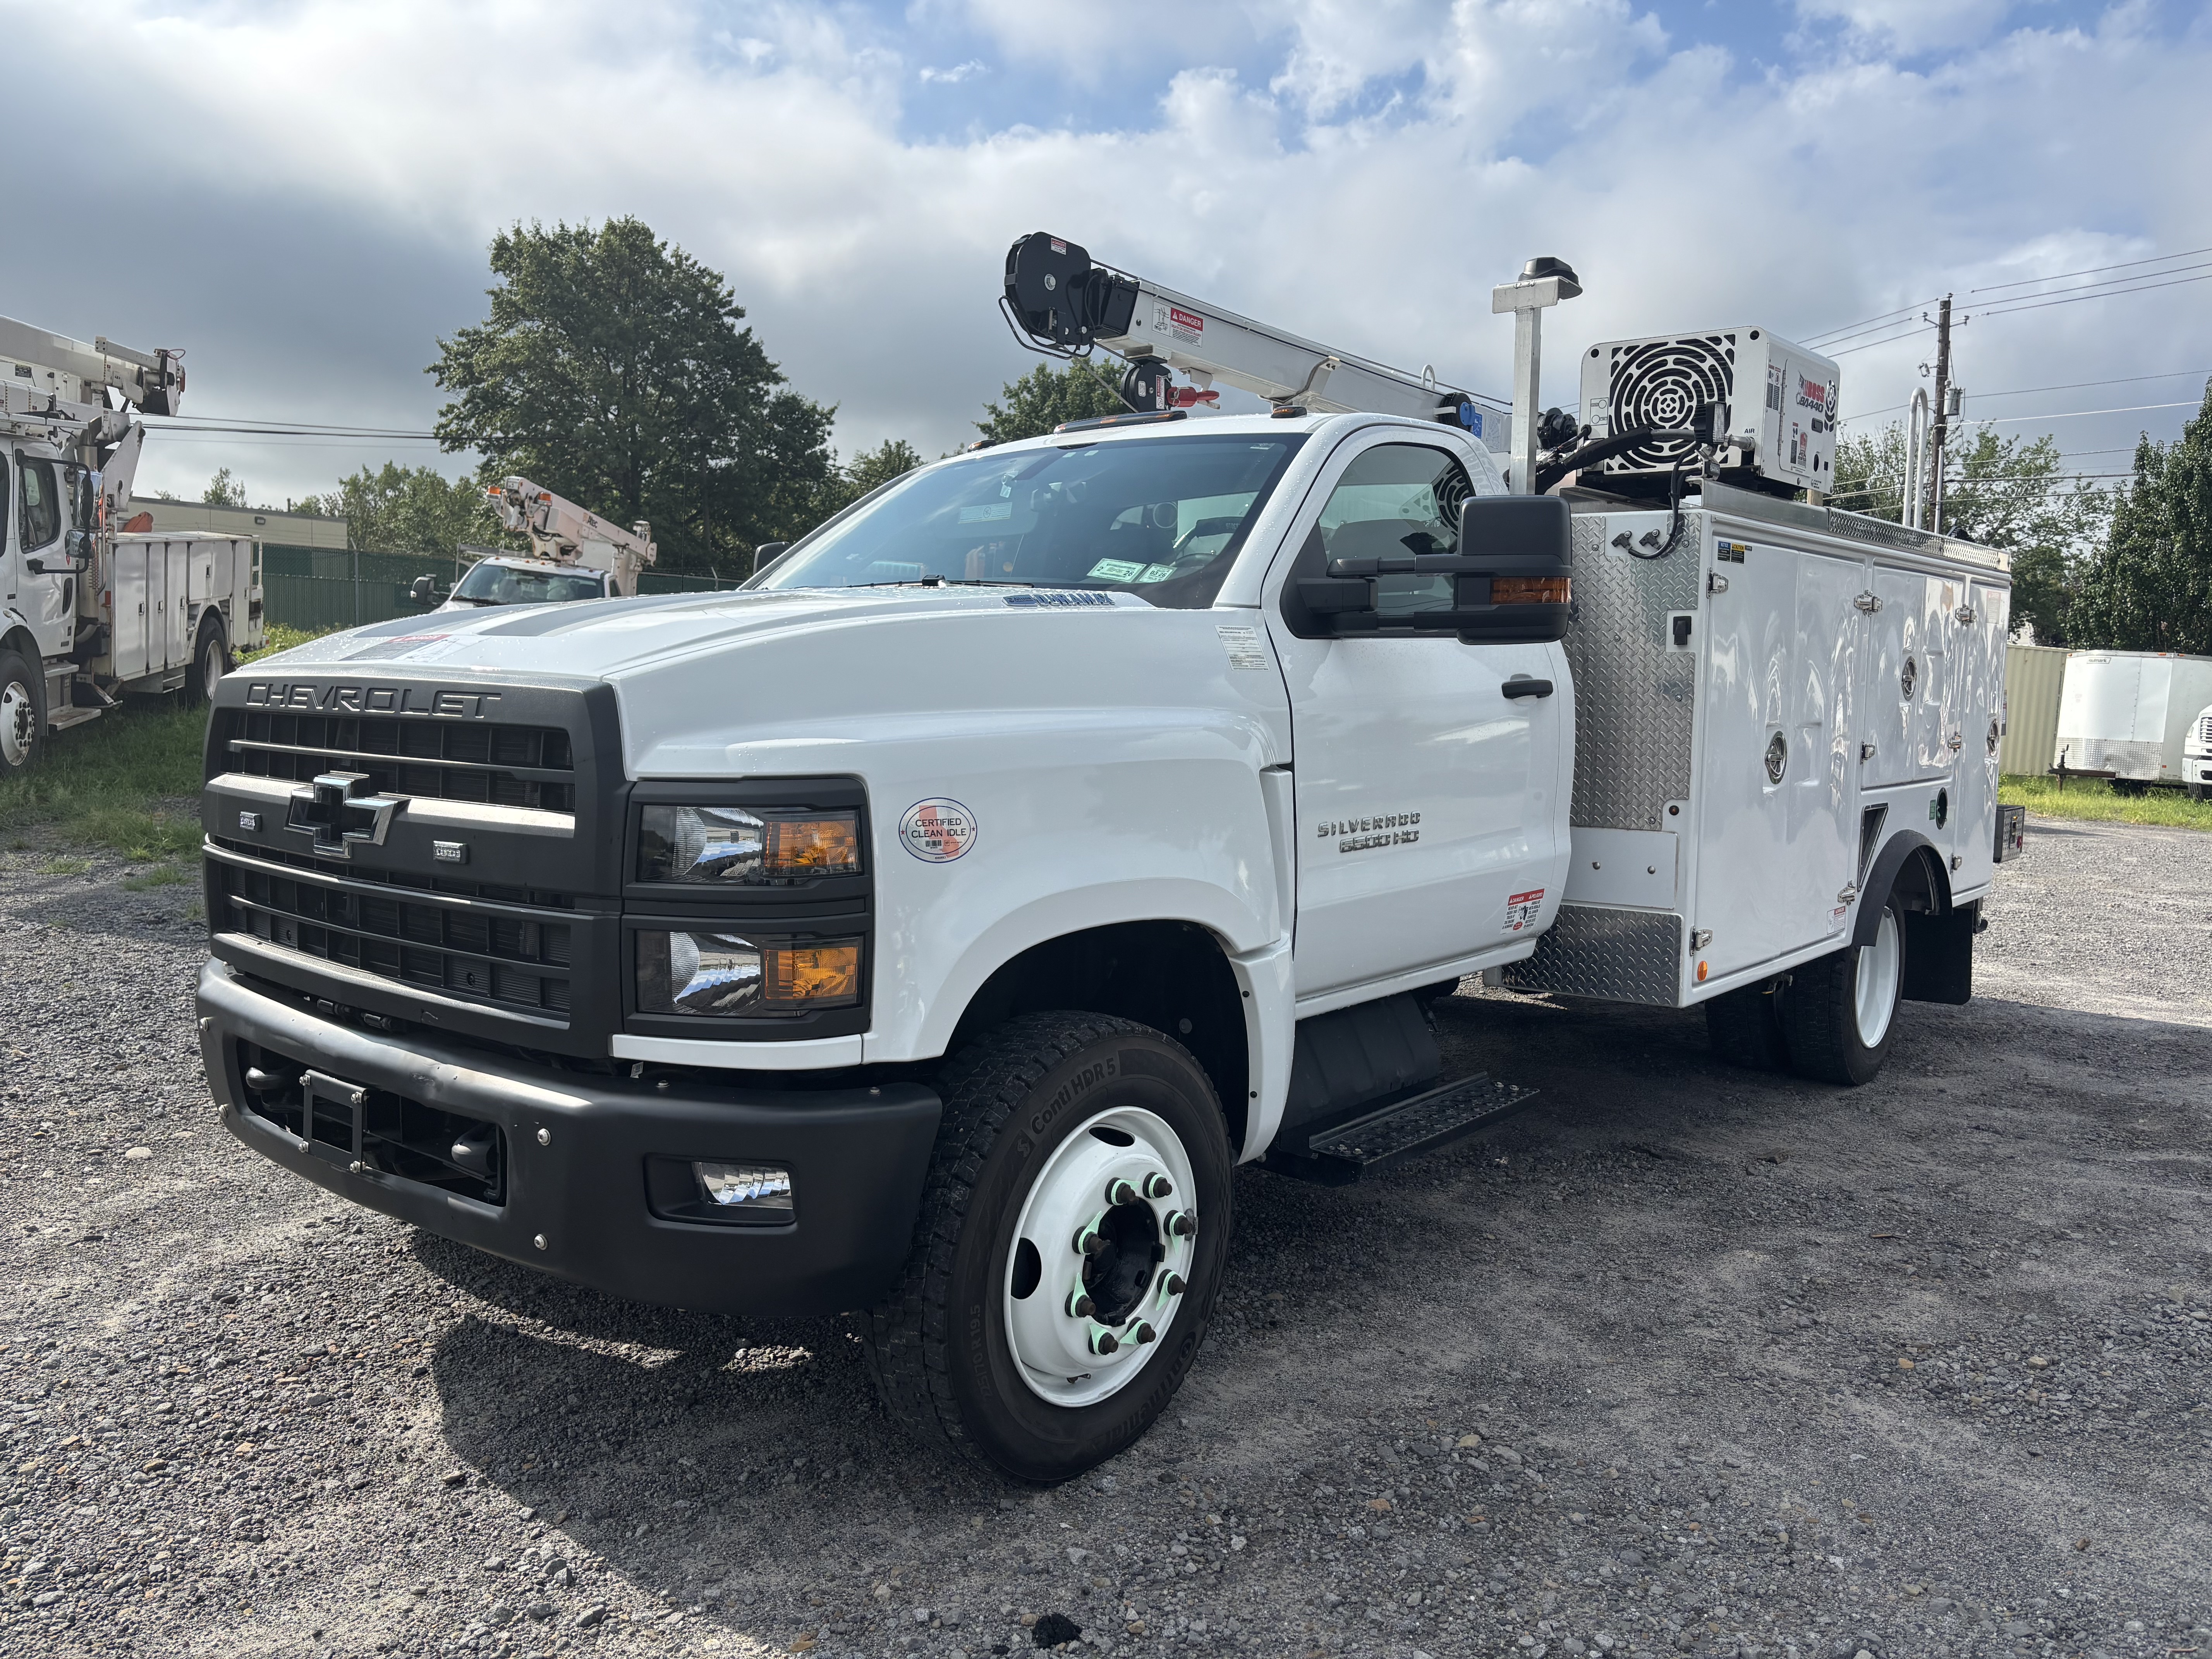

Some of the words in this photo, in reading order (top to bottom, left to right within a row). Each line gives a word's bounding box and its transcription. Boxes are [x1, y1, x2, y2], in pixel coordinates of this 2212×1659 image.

[1178, 313, 1201, 328] DANGER
[1032, 593, 1115, 606] DURAMAX
[246, 683, 501, 718] CHEVROLET
[915, 818, 962, 827] CERTIFIED
[1317, 811, 1421, 838] SILVERADO
[911, 830, 943, 838] CLEAN
[947, 828, 967, 836] IDLE
[1393, 828, 1419, 845] HD
[1031, 1085, 1072, 1135] Conti
[1070, 1063, 1106, 1095] HDR
[1106, 1057, 1116, 1076] 5
[969, 1304, 981, 1337] 19.5
